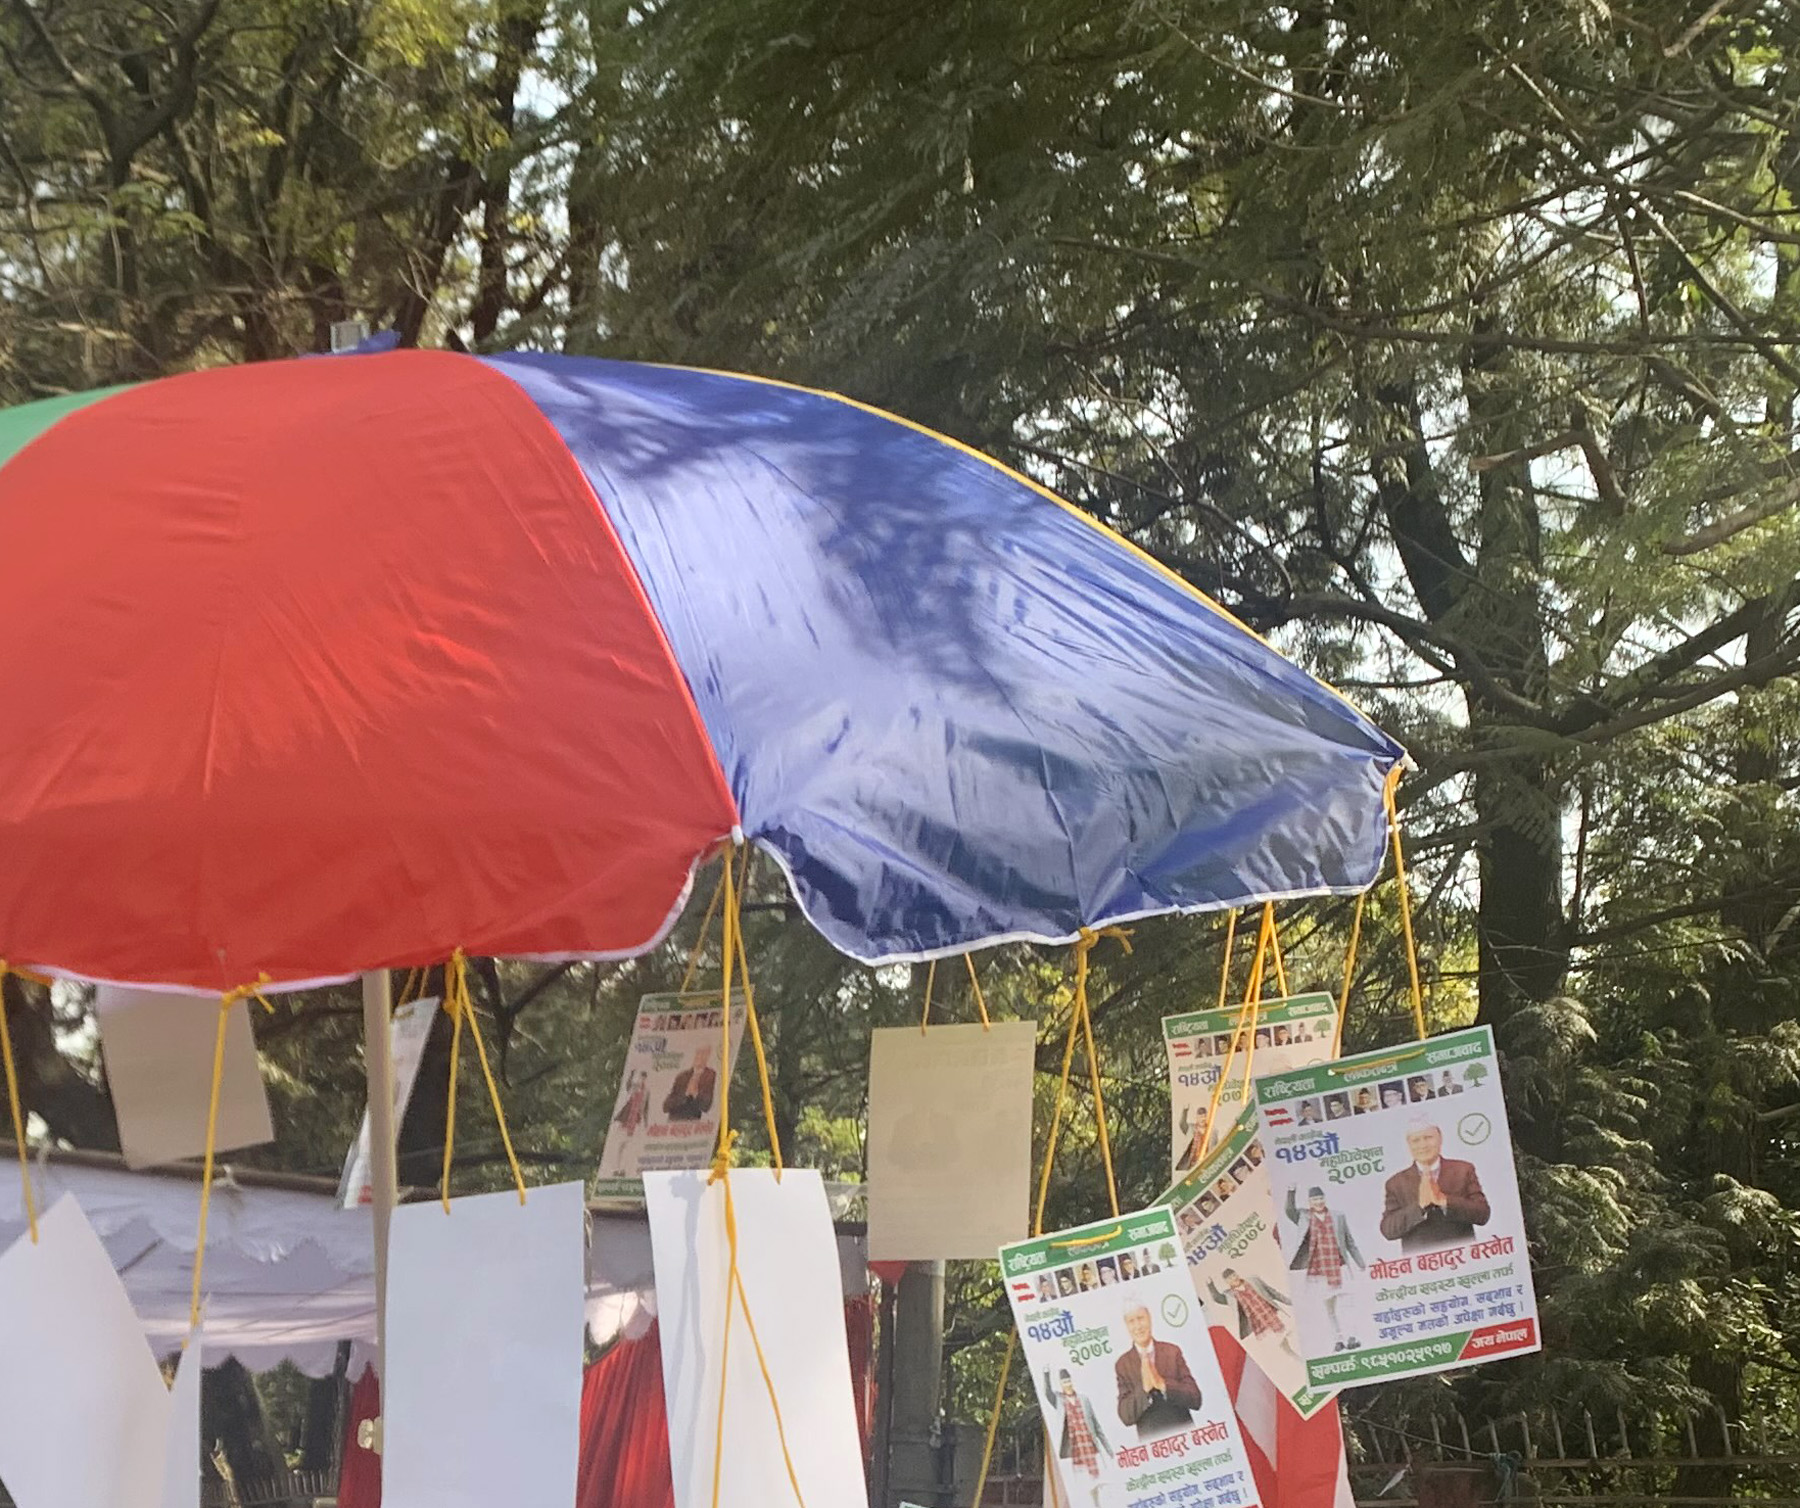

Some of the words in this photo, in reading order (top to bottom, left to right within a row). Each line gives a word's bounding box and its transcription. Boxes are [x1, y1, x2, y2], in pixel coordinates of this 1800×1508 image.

[1263, 1077, 1315, 1099] राष्ट्रियता
[1328, 1159, 1385, 1184] २०७८
[1229, 1220, 1266, 1260] २०७८
[1369, 1256, 1412, 1281] मोहन
[1418, 1246, 1466, 1271] बहादुर
[1470, 1234, 1515, 1260] बस्नेत
[1516, 1284, 1523, 1296] र
[1471, 1335, 1494, 1349] जय
[1496, 1327, 1528, 1344] नेपाल
[1069, 1340, 1113, 1366] २०७८
[1311, 1355, 1357, 1379] सम्पर्क
[1116, 1445, 1149, 1469] मोहन
[1150, 1433, 1190, 1459] बहादुर
[1191, 1420, 1229, 1446] बस्नेत
